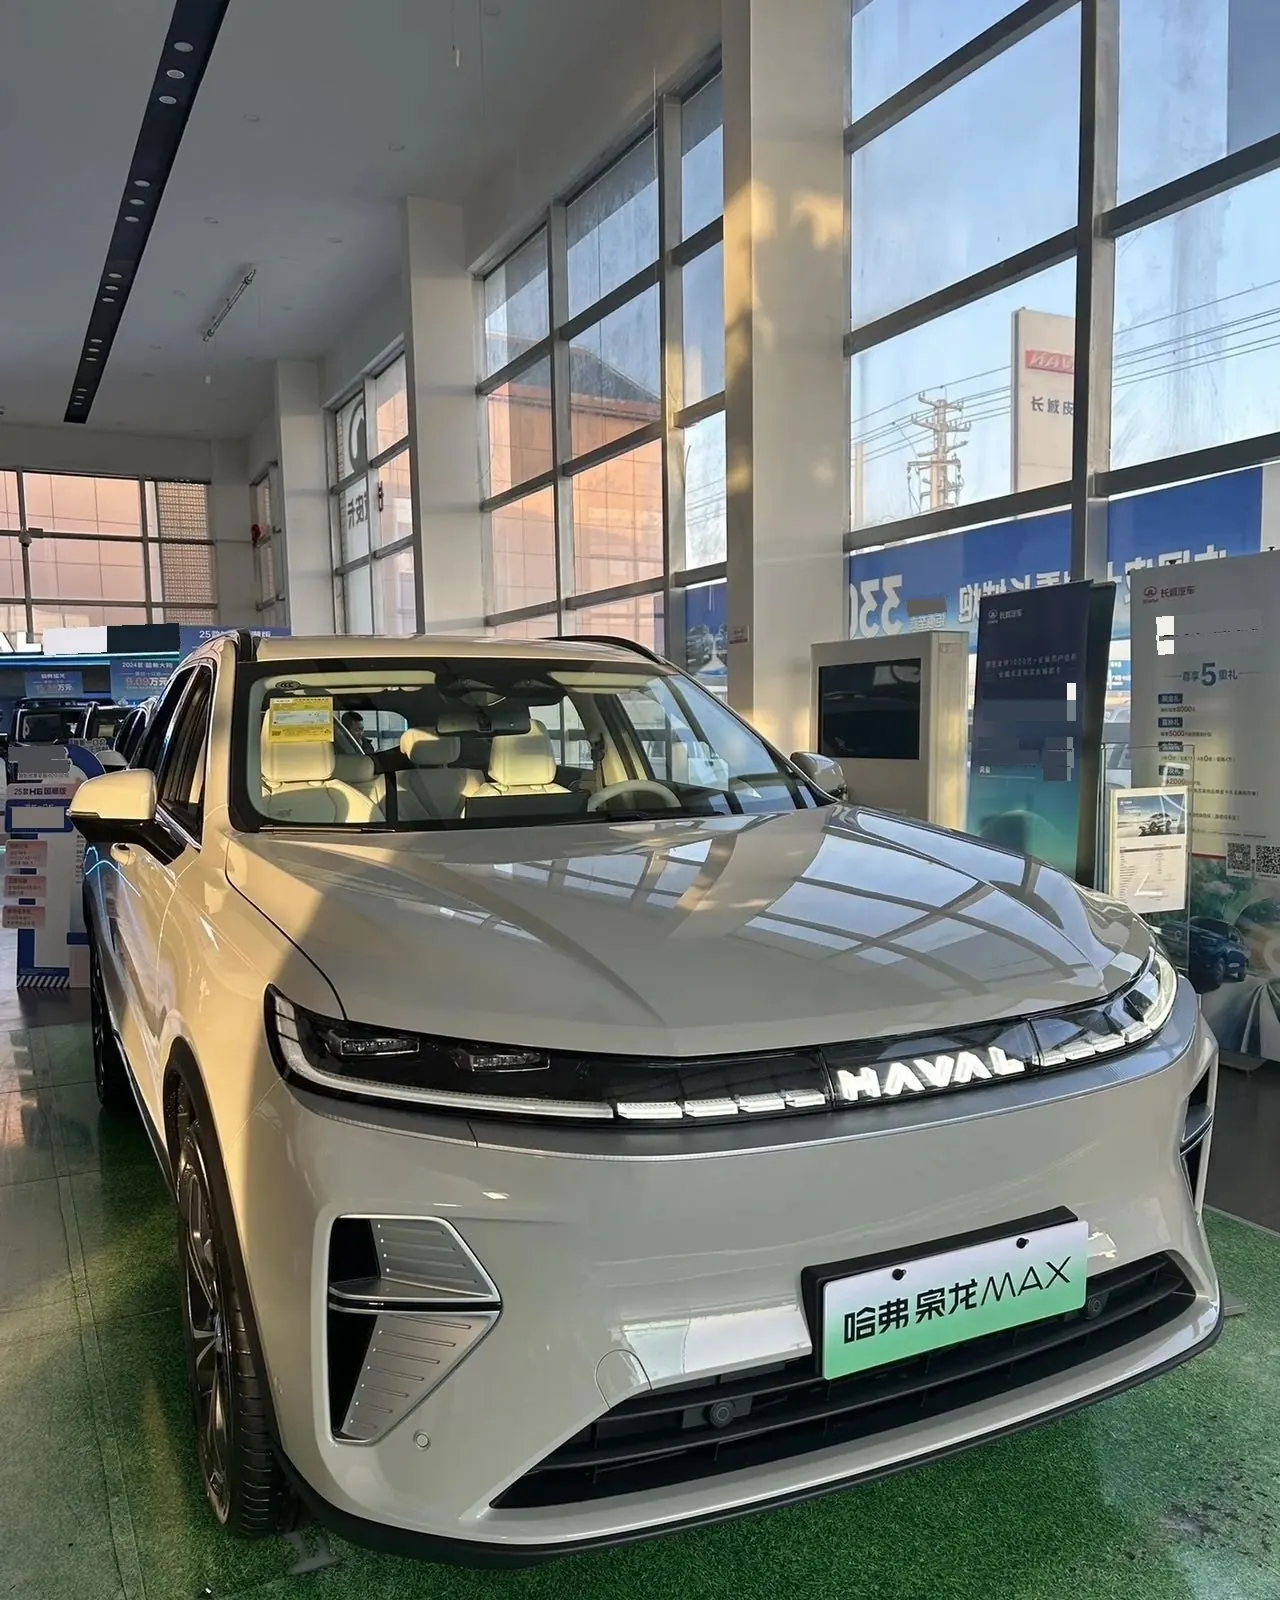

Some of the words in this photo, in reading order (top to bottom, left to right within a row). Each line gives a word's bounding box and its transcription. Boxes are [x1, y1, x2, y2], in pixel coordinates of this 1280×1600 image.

[1160, 585, 1195, 598] 长城汽车
[836, 1046, 1026, 1101] HAVAL
